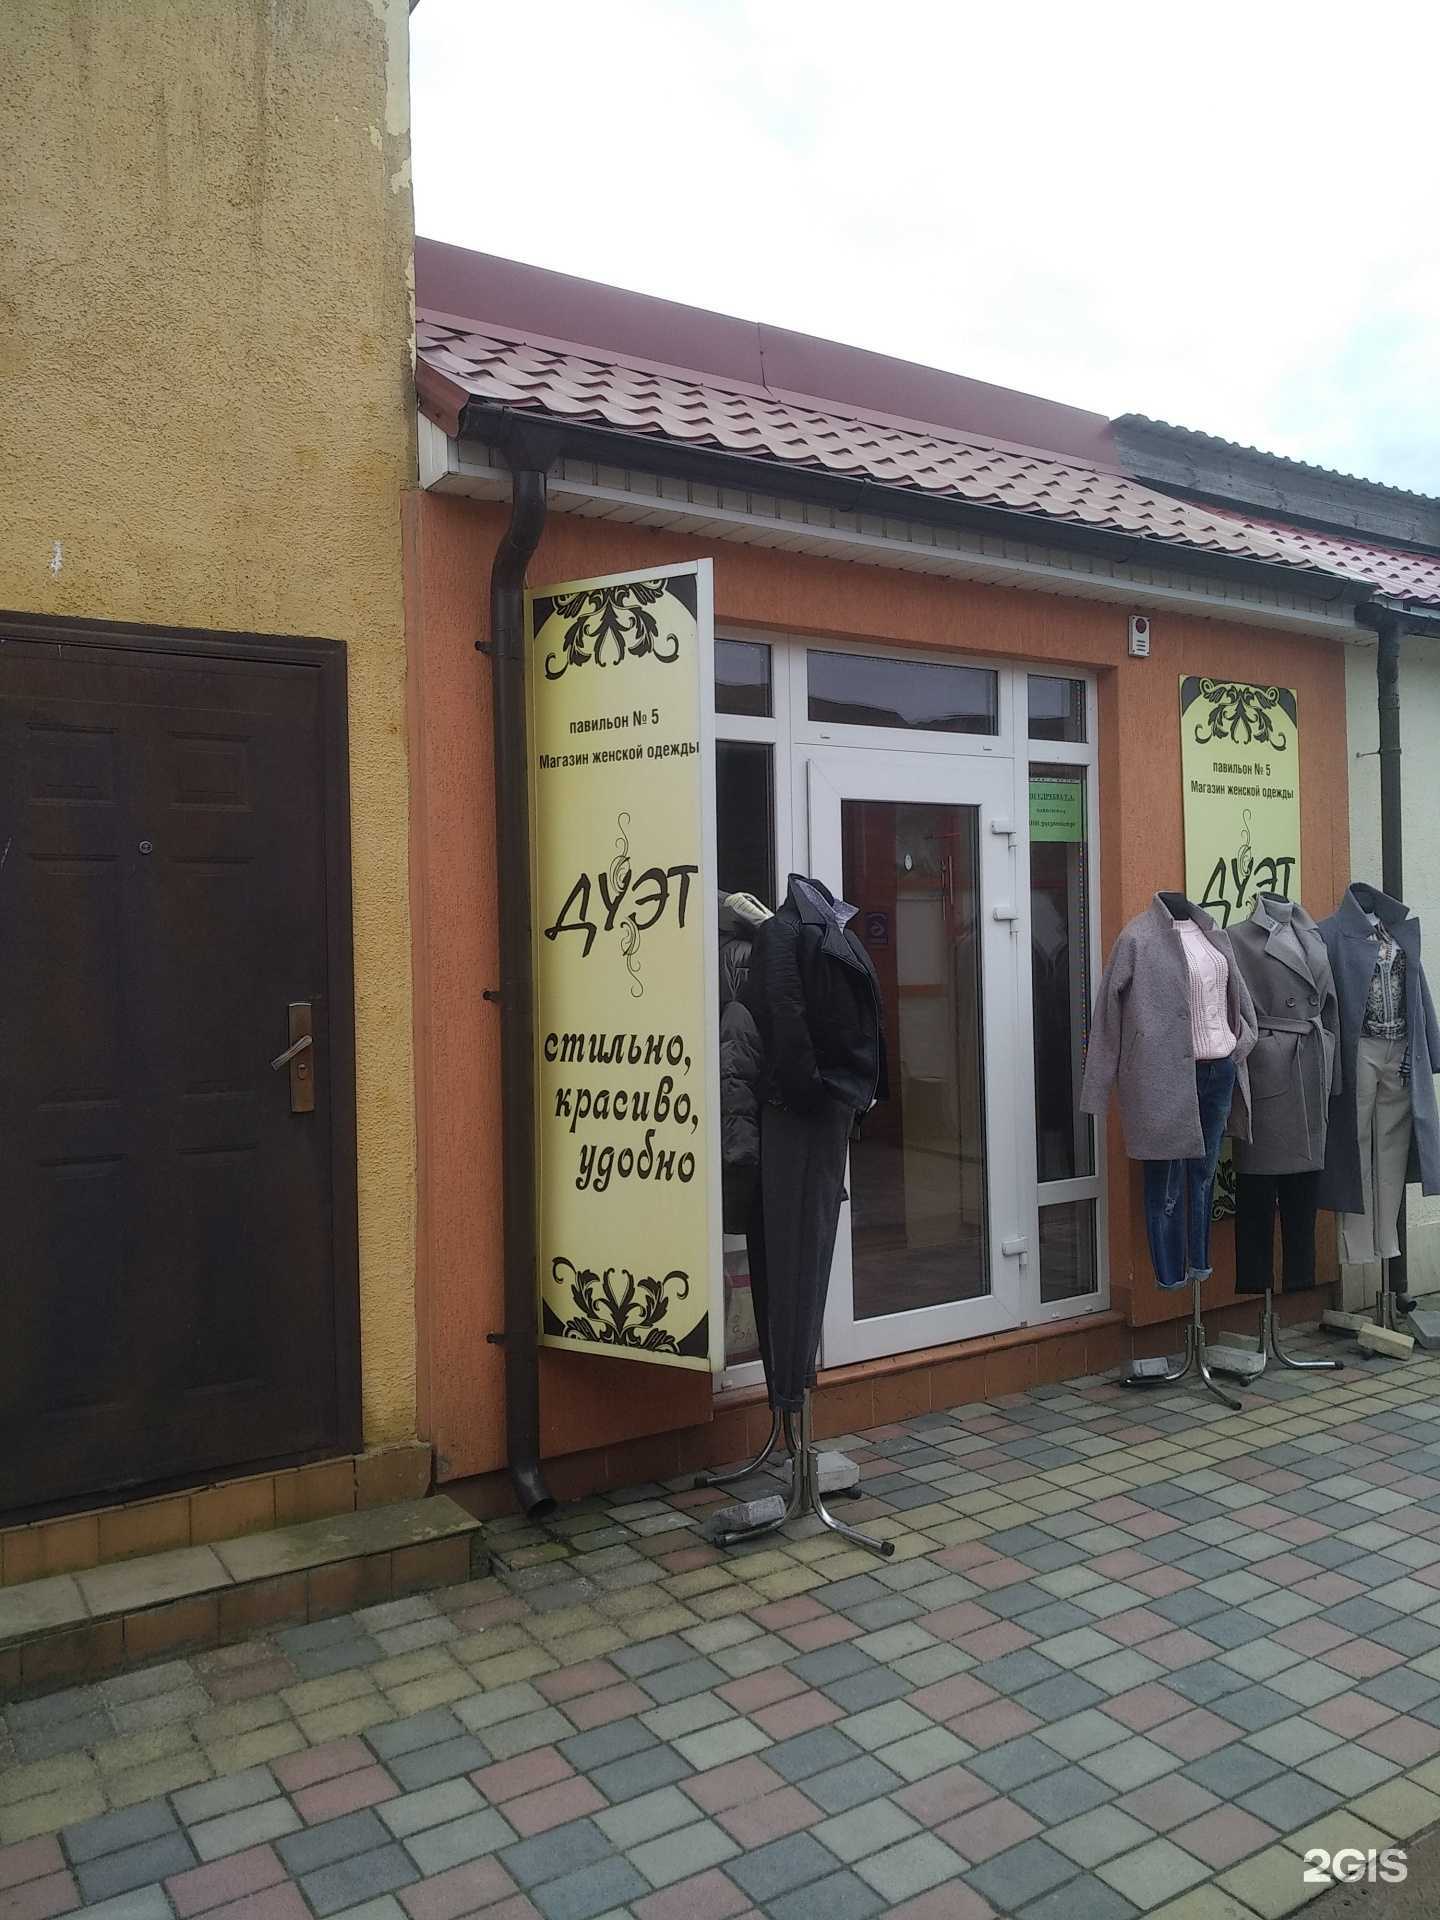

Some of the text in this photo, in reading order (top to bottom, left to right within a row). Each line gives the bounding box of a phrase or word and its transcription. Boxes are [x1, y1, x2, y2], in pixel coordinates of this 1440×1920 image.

[569, 708, 660, 734] павильон № 5
[539, 741, 700, 769] Магазин женской одежды
[1213, 762, 1252, 775] павильон
[1265, 764, 1271, 776] 5
[1191, 780, 1294, 800] Магазин женской одежды
[544, 864, 699, 958] ДУЭТ
[1198, 857, 1295, 930] ДУЭТ
[544, 1032, 692, 1076] стильно,
[555, 1075, 699, 1136] красиво,
[575, 1128, 695, 1193] удобно
